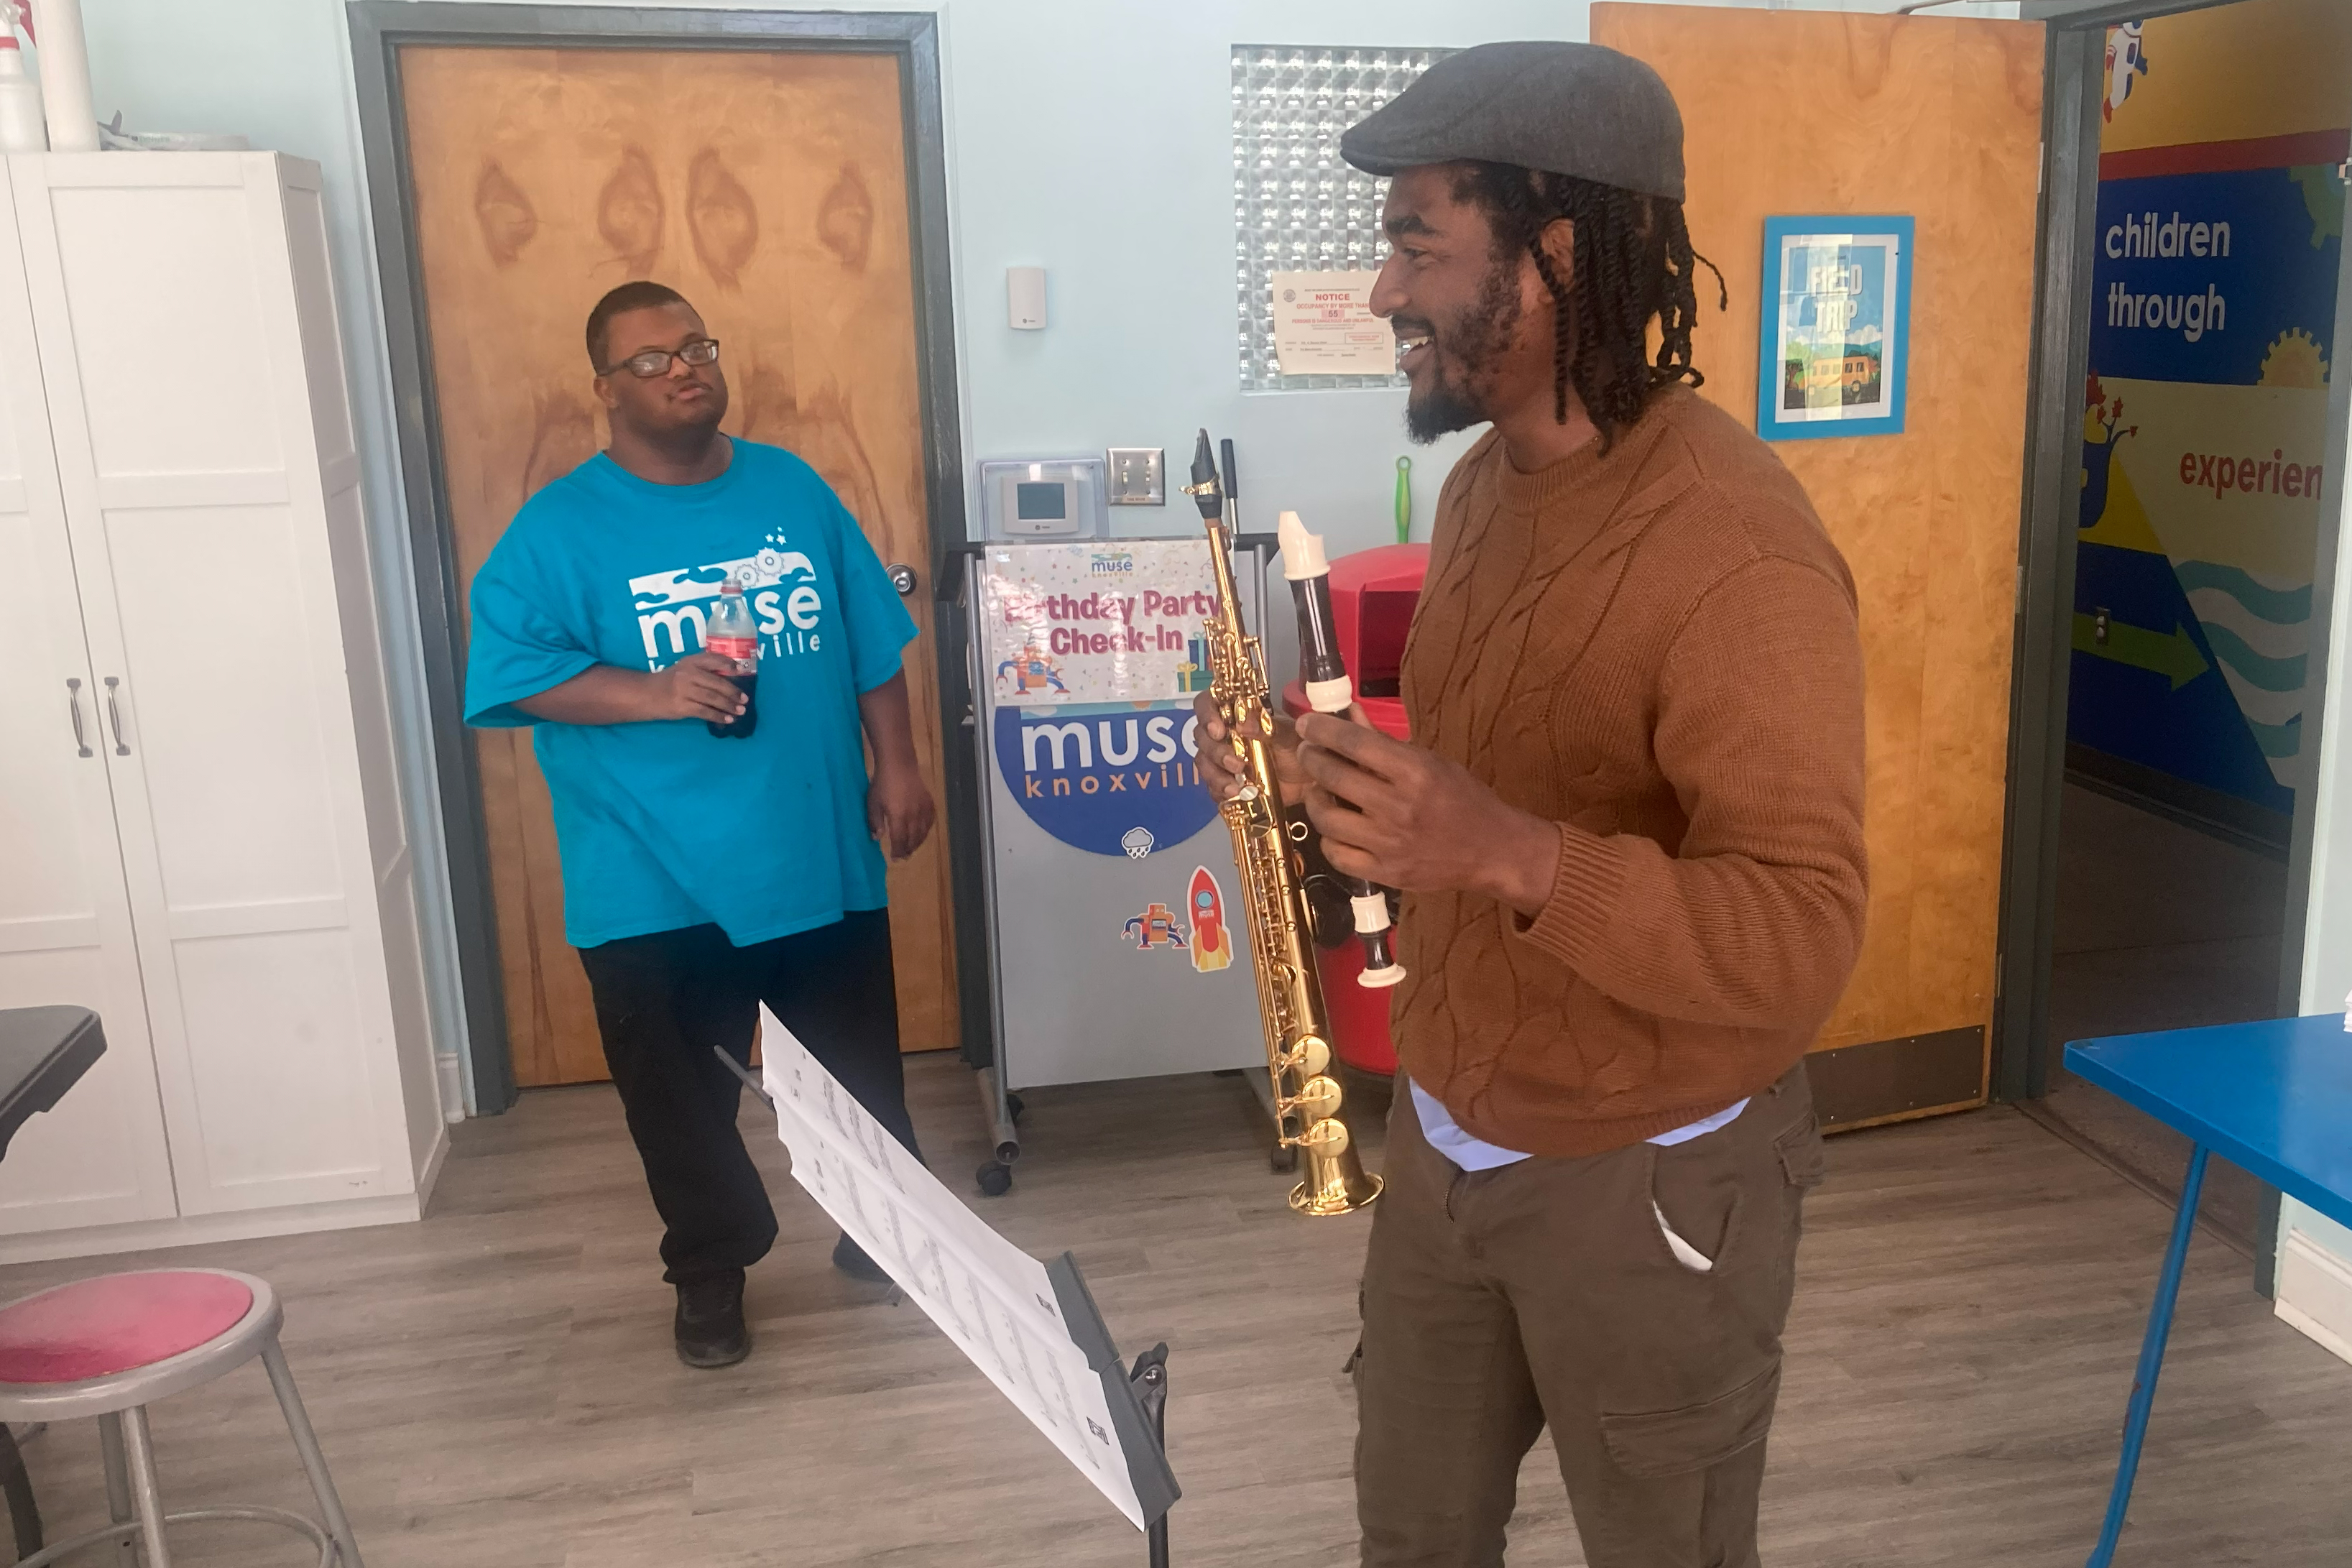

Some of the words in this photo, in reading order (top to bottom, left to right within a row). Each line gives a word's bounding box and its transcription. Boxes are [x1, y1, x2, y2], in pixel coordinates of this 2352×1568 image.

[2105, 211, 2231, 259] children
[1810, 264, 1863, 298] FIELD
[1814, 300, 1858, 333] TRIP
[2107, 282, 2226, 343] through
[2180, 448, 2323, 500] experien
[1092, 561, 1133, 572] muse
[638, 586, 822, 658] mse
[1003, 591, 1135, 625] Bthday
[1143, 590, 1219, 617] Party
[648, 630, 821, 673] kville
[1050, 624, 1184, 655] Check-In
[1025, 762, 1199, 798] knoxvill
